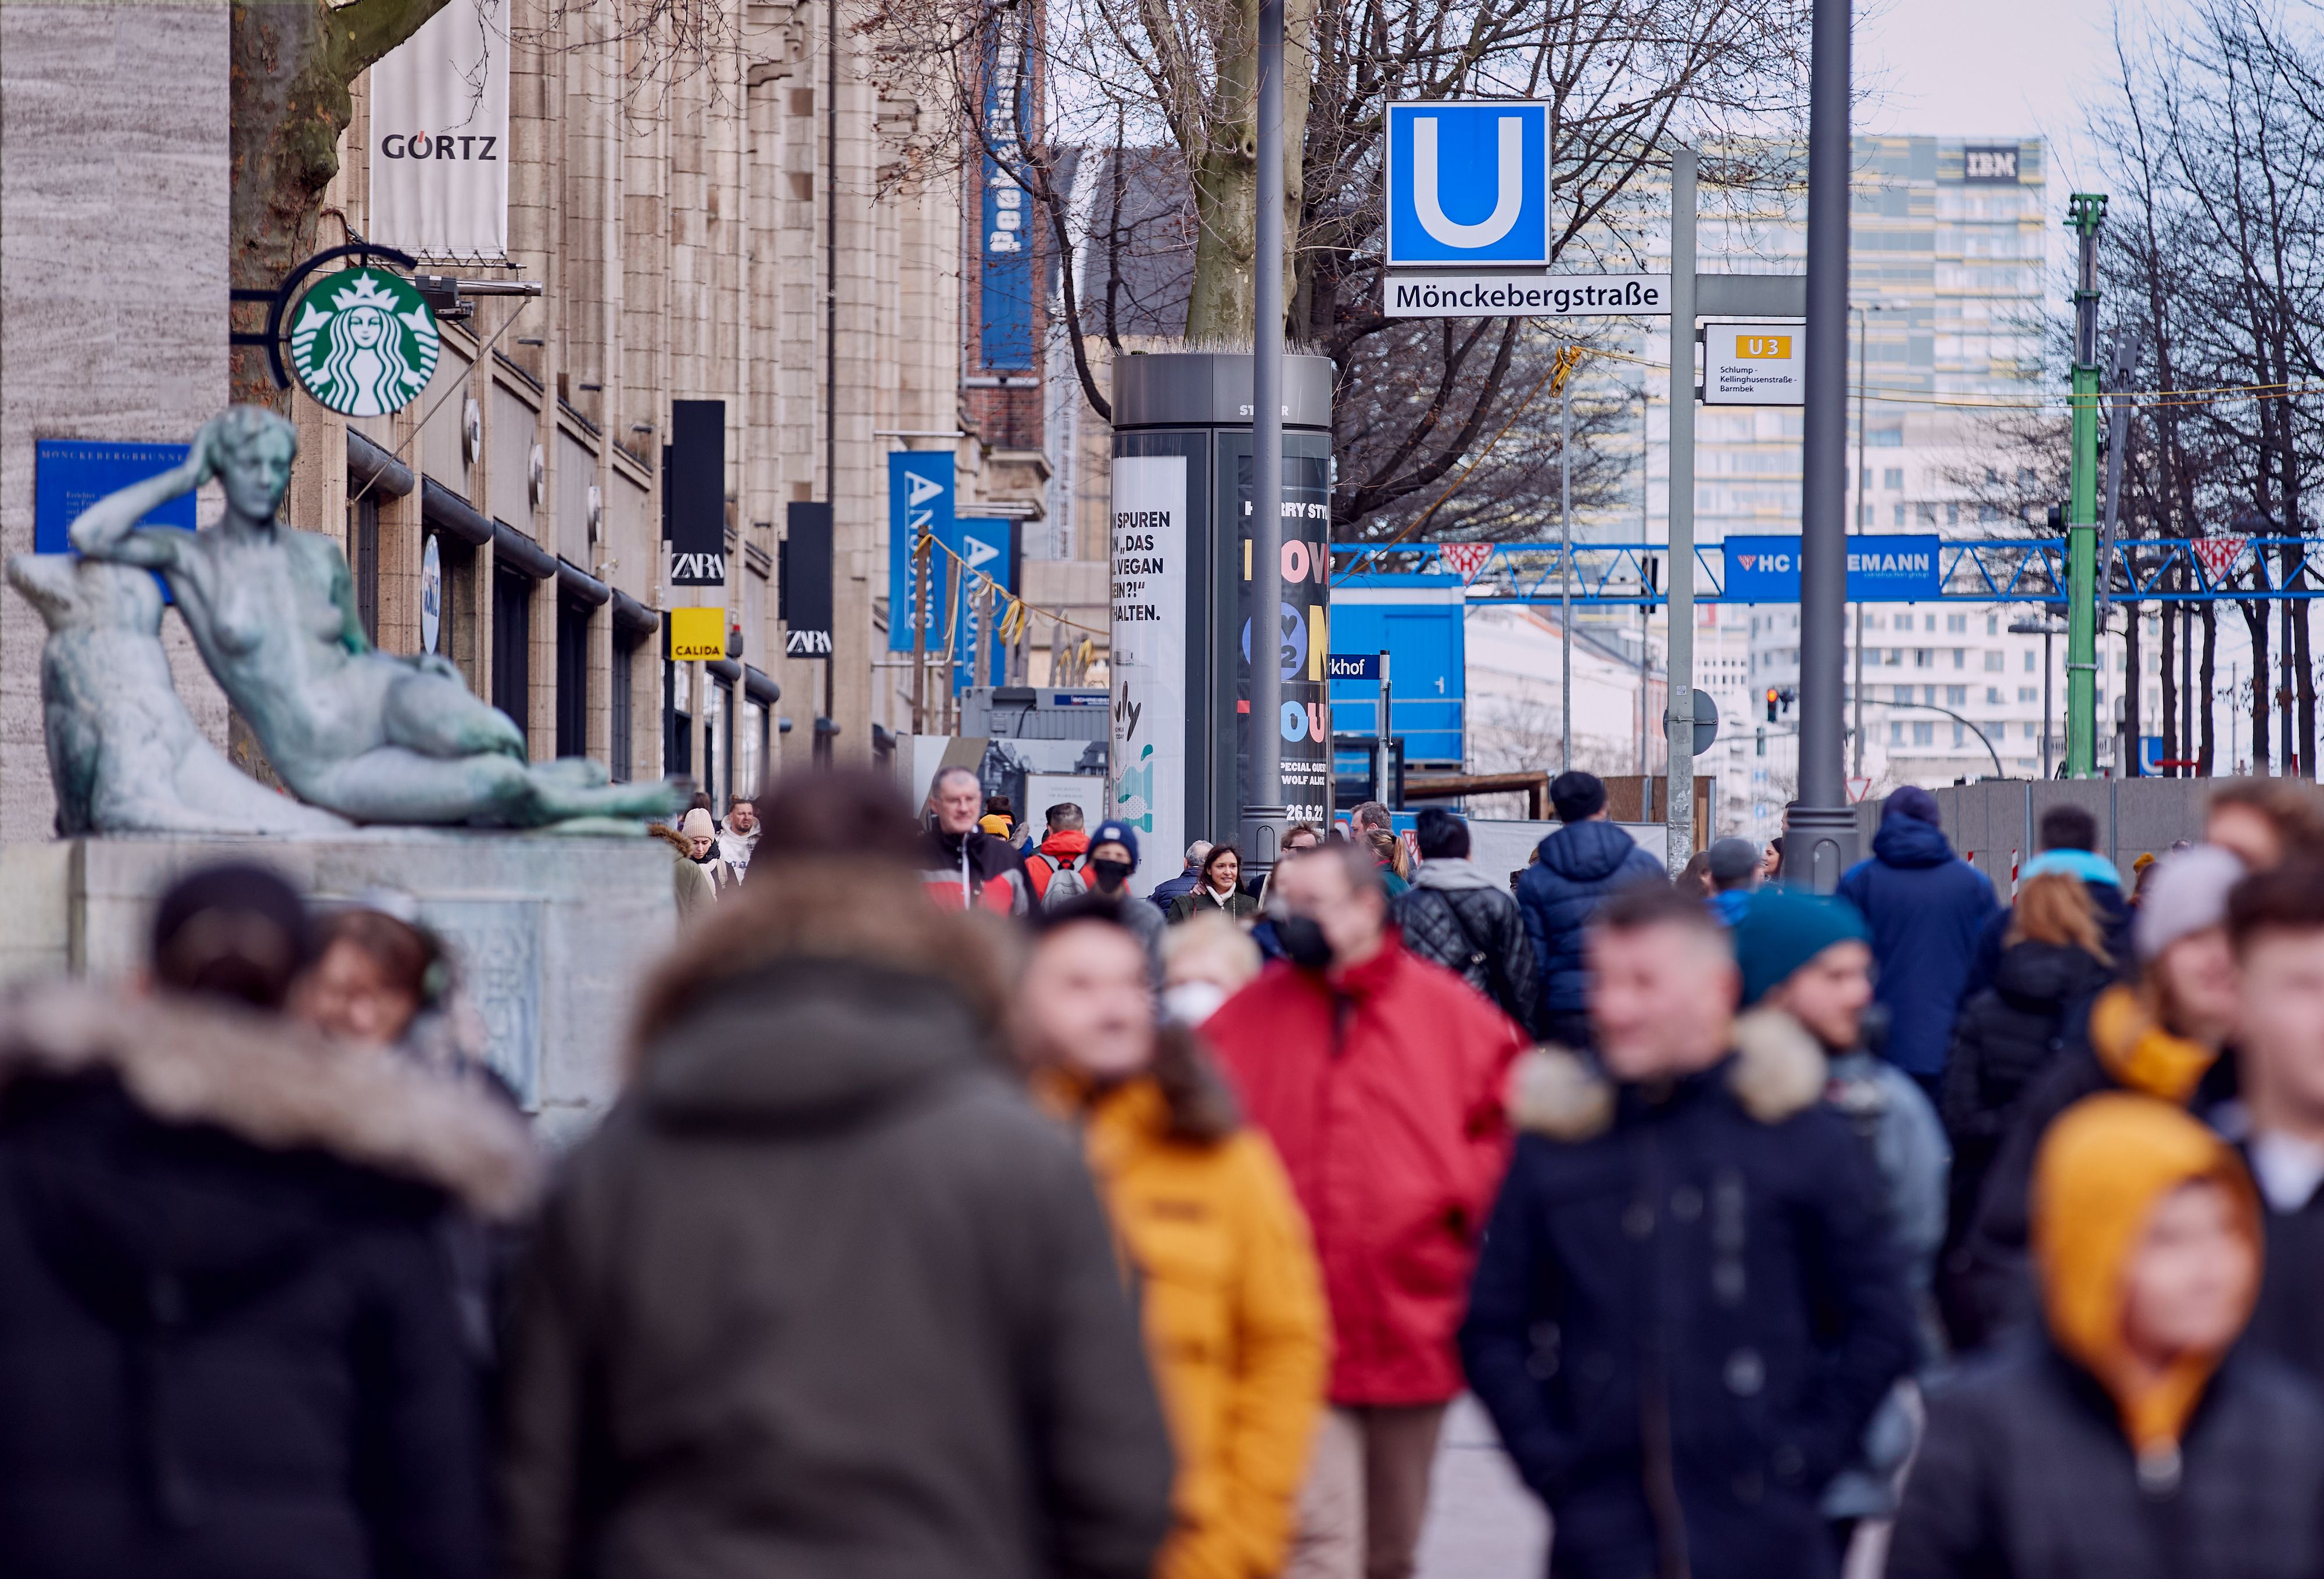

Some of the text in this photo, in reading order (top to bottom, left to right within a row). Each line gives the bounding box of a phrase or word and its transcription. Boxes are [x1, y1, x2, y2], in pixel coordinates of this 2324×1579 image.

[1967, 152, 2016, 177] IBM
[1414, 117, 1523, 249] U
[1396, 281, 1659, 313] Mönckebergstraße
[1749, 339, 1779, 356] U 3
[1720, 366, 1753, 374] Schlump
[1720, 375, 1793, 385] Kellinghusenstraße
[1239, 404, 1289, 416] STR
[1118, 511, 1170, 529] SPUREN
[671, 553, 724, 578] ZARA
[1118, 558, 1164, 575] VEGAN
[1759, 554, 1790, 572] HC
[786, 630, 832, 653] ZARA
[675, 645, 720, 656] CALIDA
[1281, 775, 1325, 786] WOLF ALICE
[1286, 804, 1323, 821] 26.6.22
